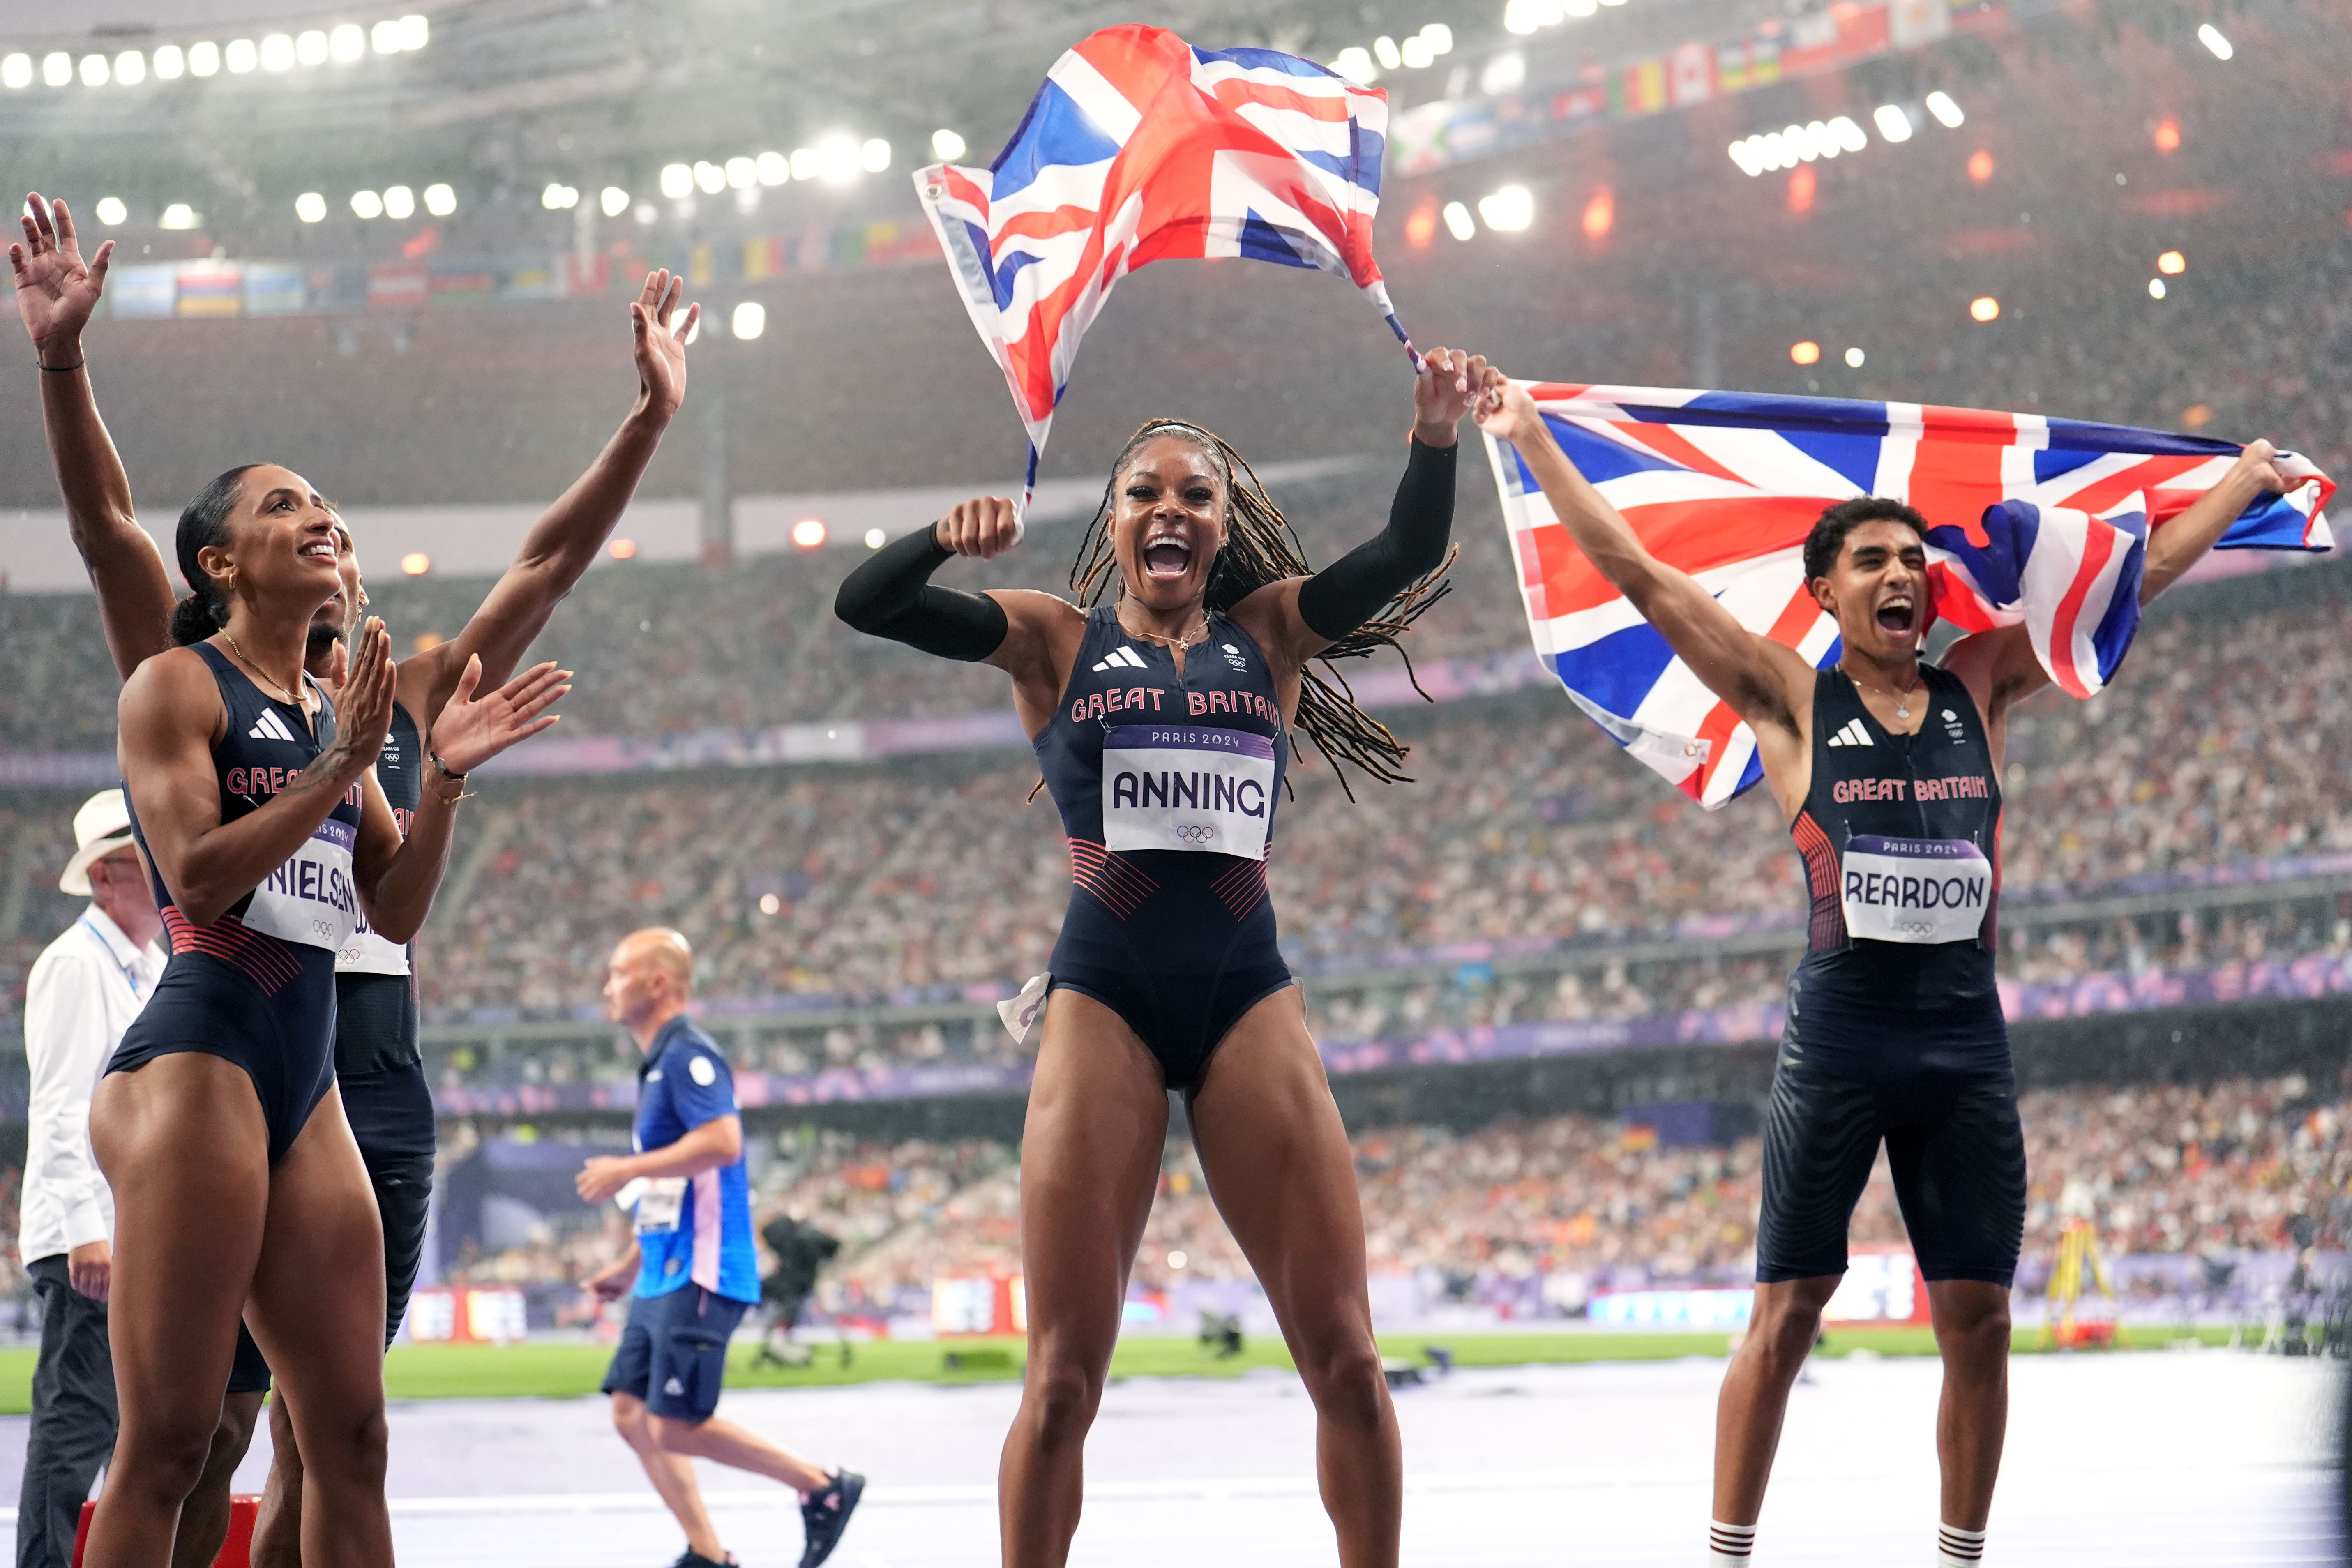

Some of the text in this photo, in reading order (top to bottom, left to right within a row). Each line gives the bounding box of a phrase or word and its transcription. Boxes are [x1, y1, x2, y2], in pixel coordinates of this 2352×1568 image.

[1072, 687, 1280, 731] GREAT BRITAIN
[1202, 733, 1238, 747] 2024
[1113, 771, 1264, 818] ANNING
[1833, 776, 1989, 803] GREAT BRITAIN
[330, 826, 349, 842] 2024
[1925, 844, 1958, 855] 2024
[1846, 872, 1984, 909] REARDON
